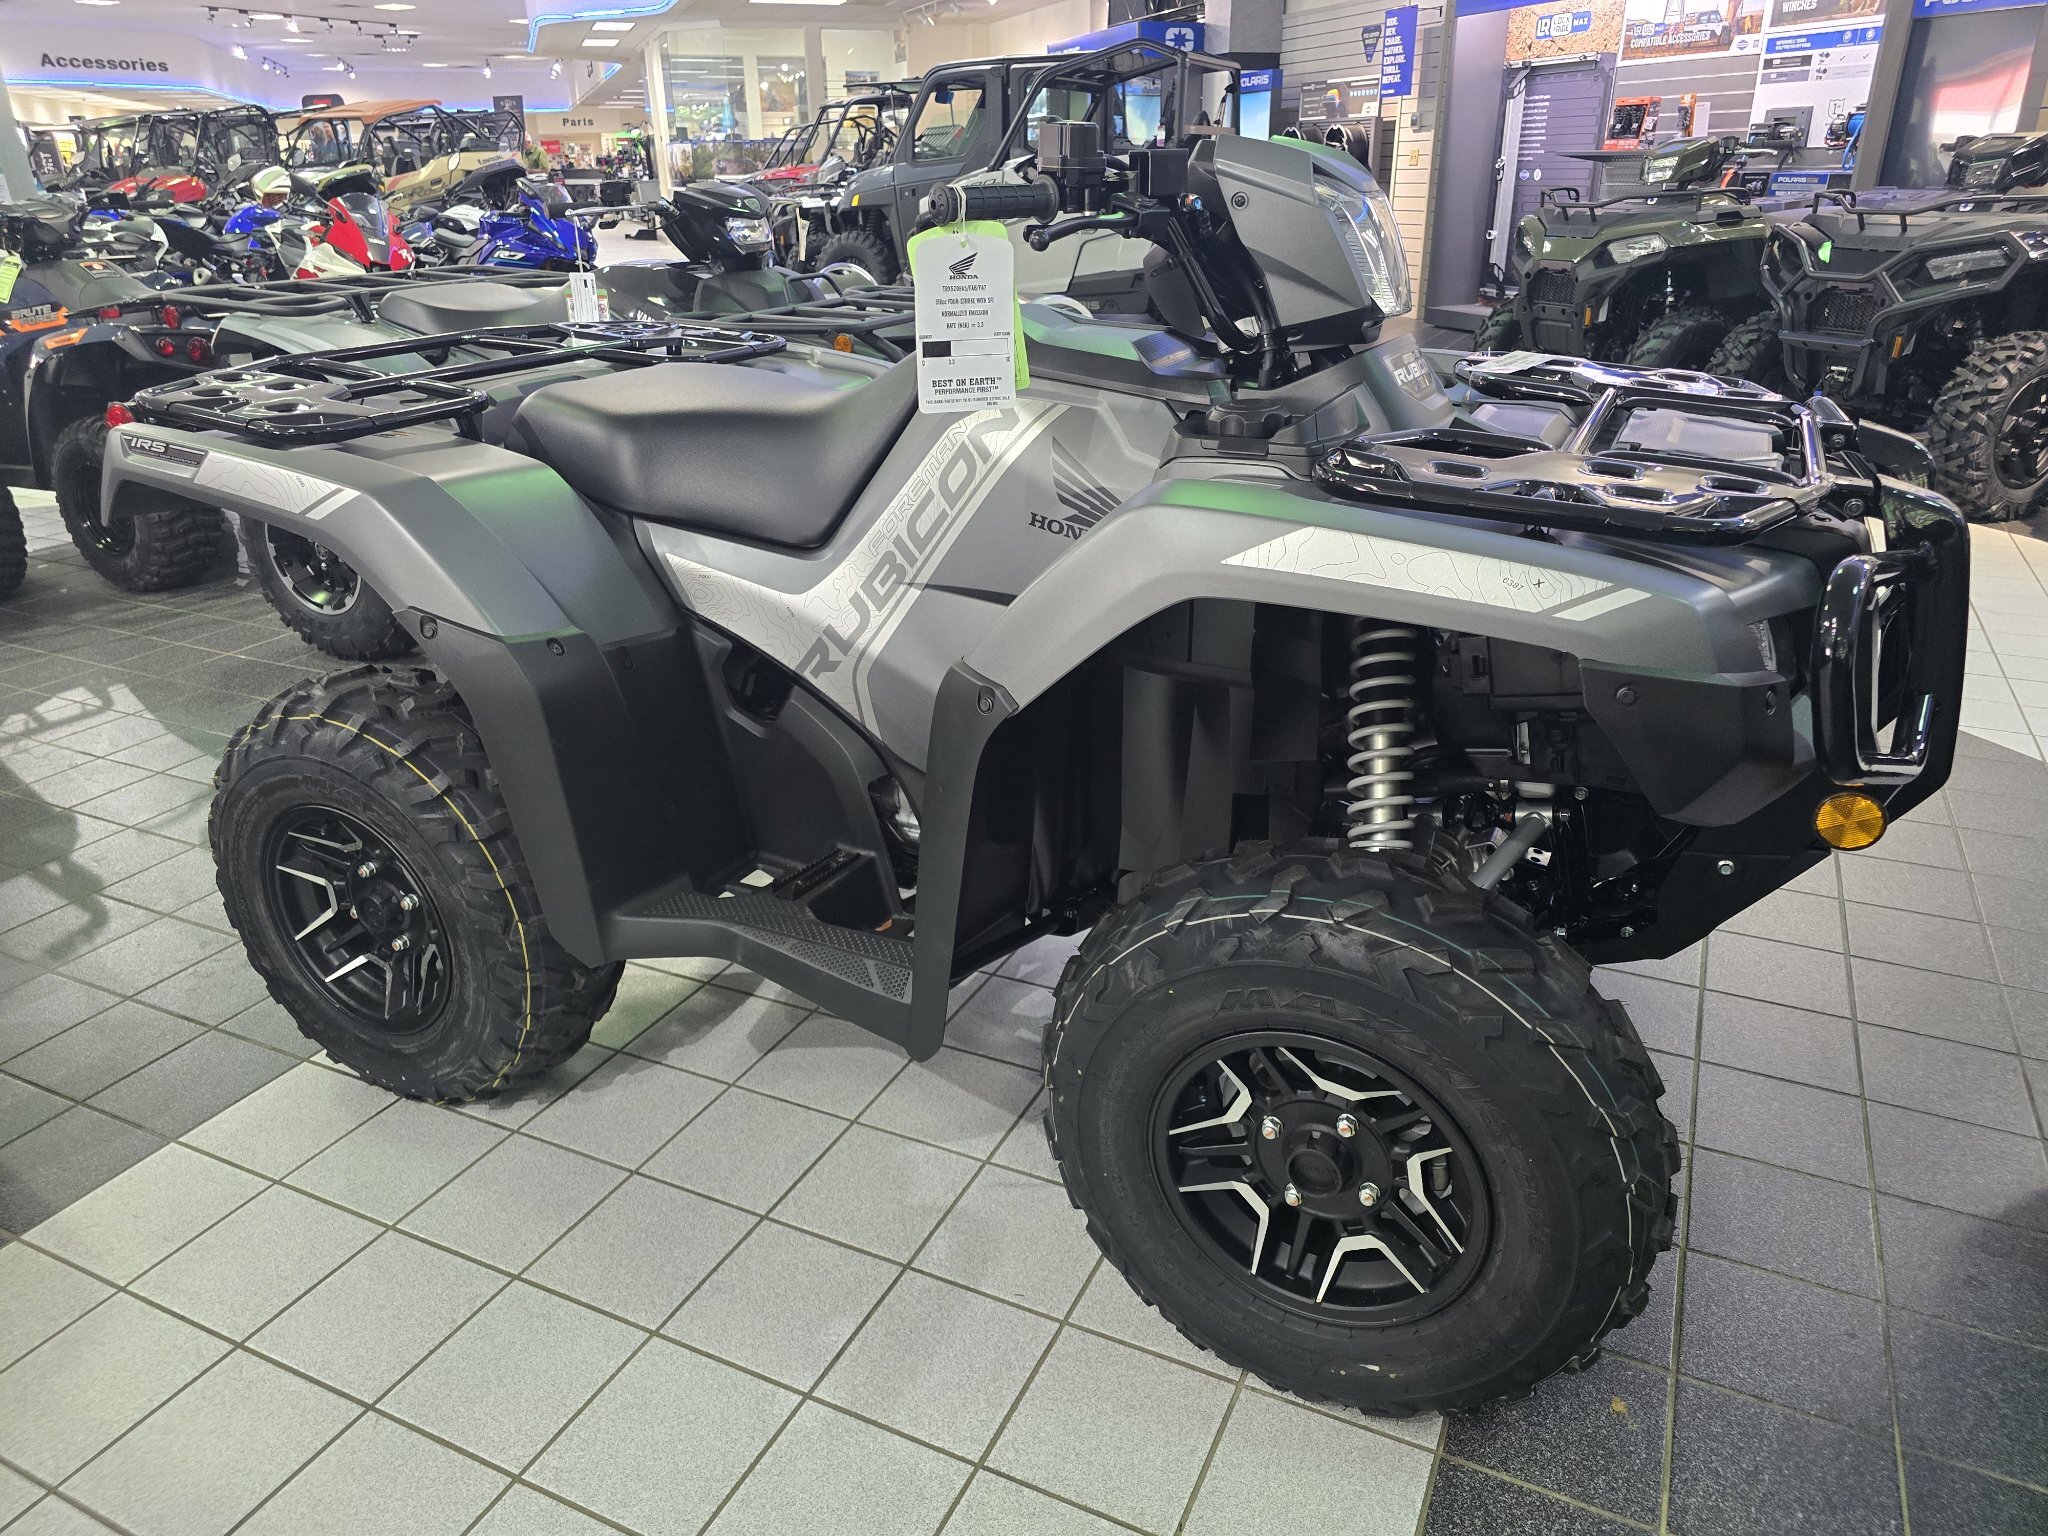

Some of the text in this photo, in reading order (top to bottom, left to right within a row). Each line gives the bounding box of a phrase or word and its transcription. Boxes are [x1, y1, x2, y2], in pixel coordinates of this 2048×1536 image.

[1573, 17, 1588, 27] MAX
[41, 53, 169, 73] Accessories
[1241, 75, 1270, 87] OLARIS
[562, 117, 594, 127] Parts
[11, 304, 52, 319] BRUTE
[20, 311, 58, 326] FORCE
[932, 380, 953, 388] BEST
[956, 379, 967, 387] ON
[934, 387, 976, 396] PERFORMANCE
[131, 437, 167, 453] IRS
[868, 421, 968, 558] FOREMAN
[1028, 511, 1089, 541] HON
[795, 408, 1021, 680] RUBICON
[1502, 576, 1525, 591] 6387
